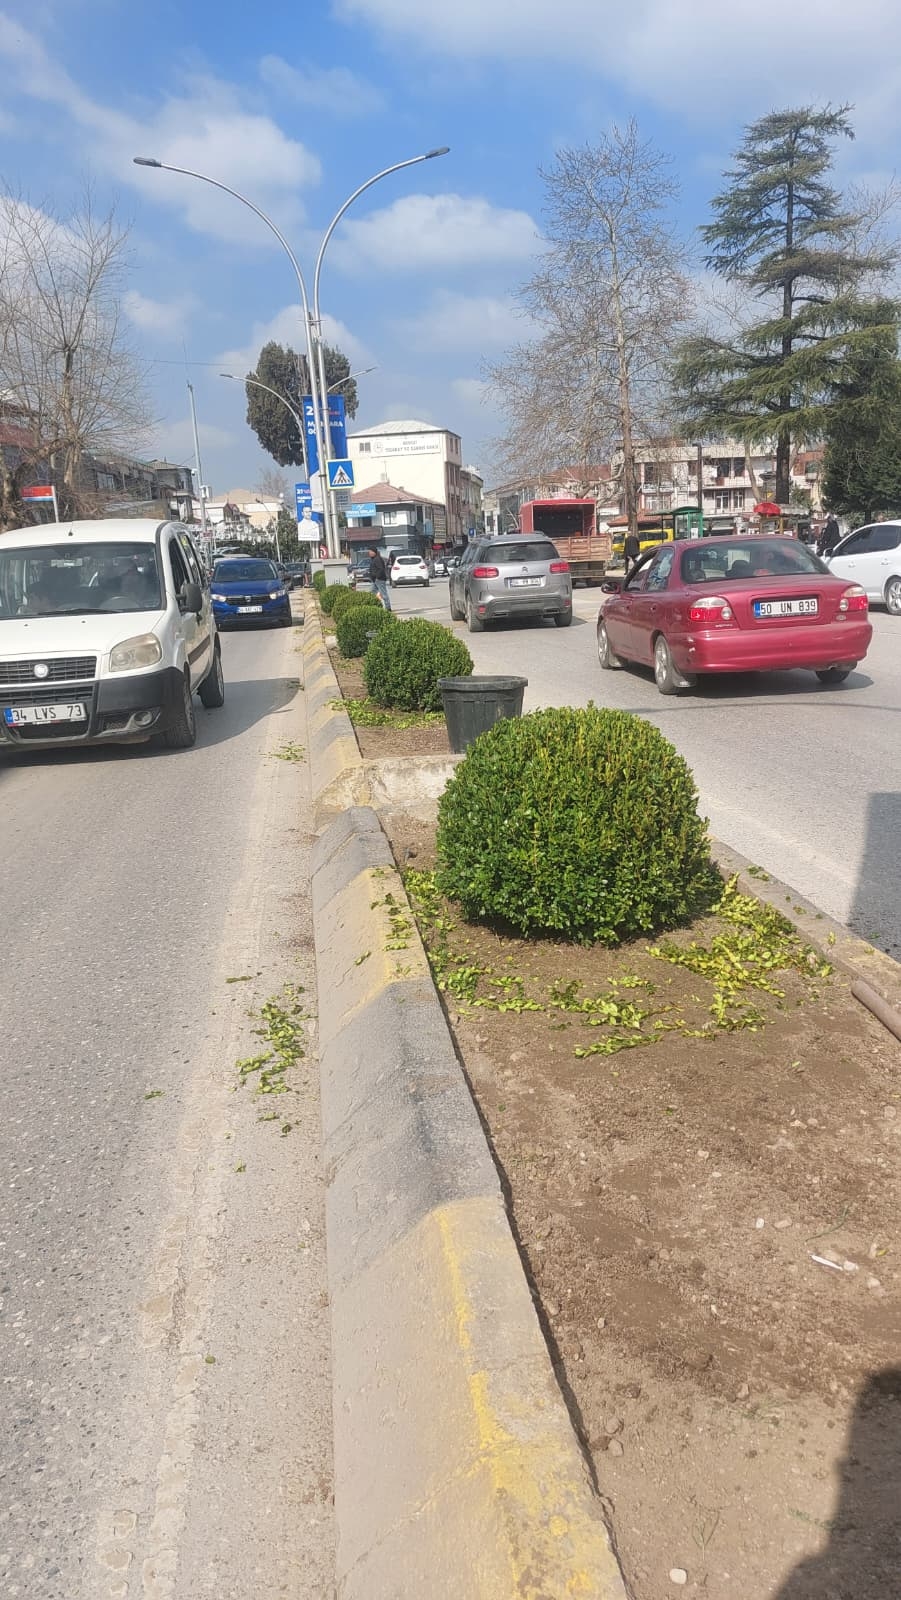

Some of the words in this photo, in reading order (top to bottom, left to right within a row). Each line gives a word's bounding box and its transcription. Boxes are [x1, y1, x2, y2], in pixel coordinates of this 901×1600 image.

[761, 603, 772, 614] 50
[780, 602, 792, 613] UN
[799, 600, 816, 612] 839
[12, 709, 27, 722] 34
[34, 707, 57, 720] LVS
[67, 705, 82, 717] 73
